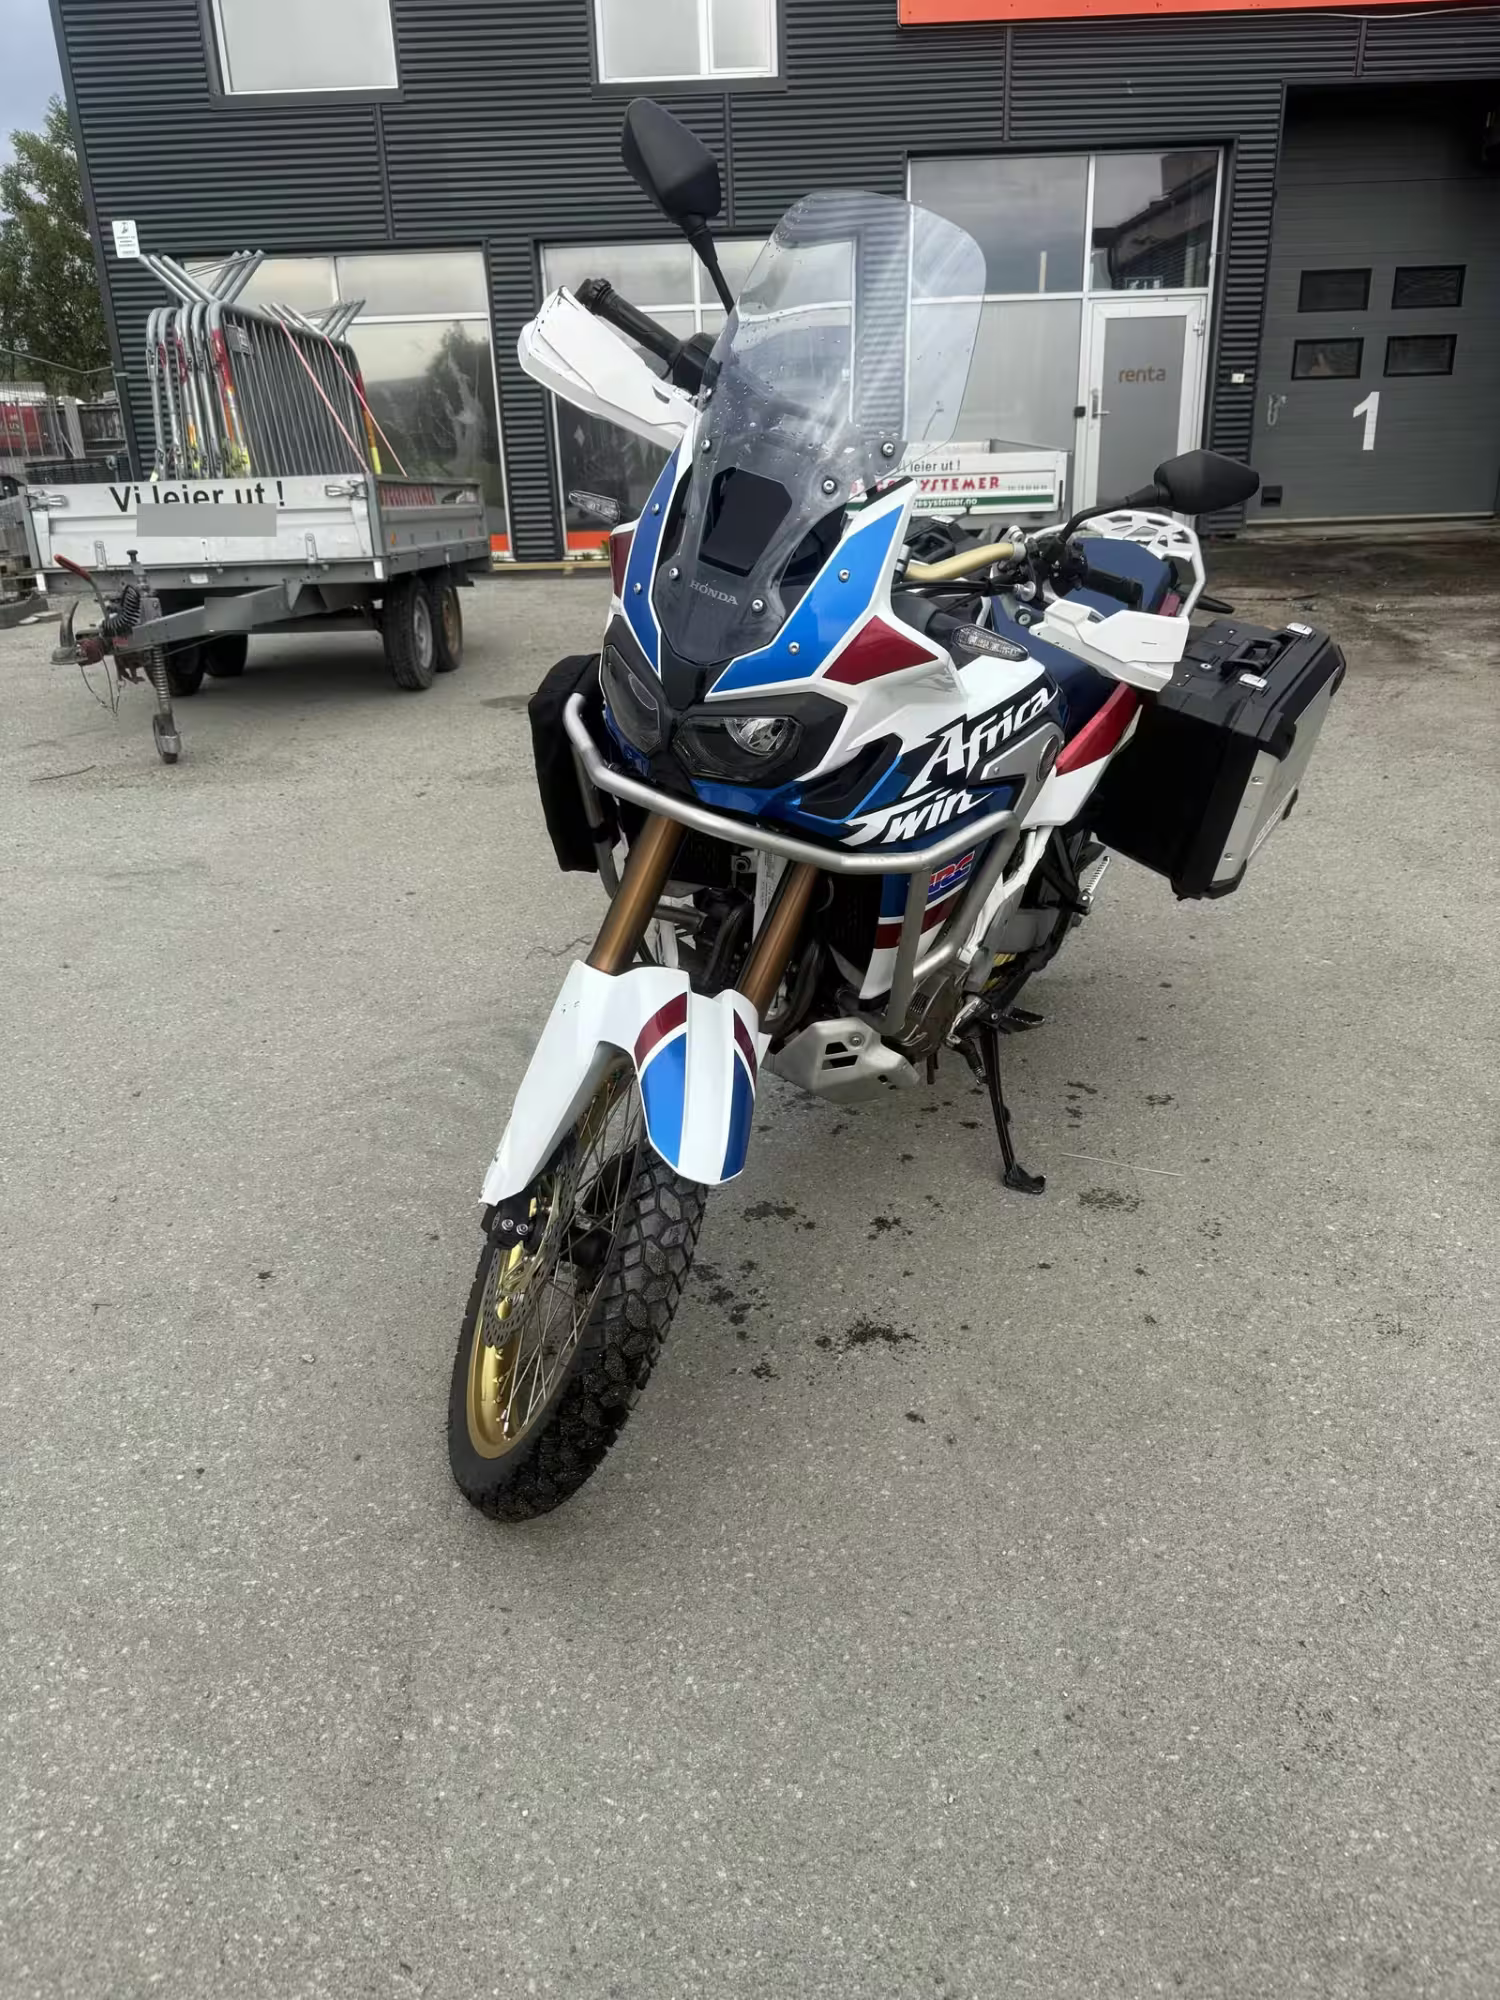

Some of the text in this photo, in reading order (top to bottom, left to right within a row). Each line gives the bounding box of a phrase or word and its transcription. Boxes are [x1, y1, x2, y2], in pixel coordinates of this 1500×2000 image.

[1118, 366, 1167, 383] renta
[1353, 391, 1380, 451] 1
[910, 460, 937, 473] leier
[940, 462, 954, 472] ut
[108, 480, 285, 513] Vi leier ut !
[689, 579, 739, 606] HONDA
[902, 687, 1055, 798] Africa
[839, 786, 993, 847] Twin
